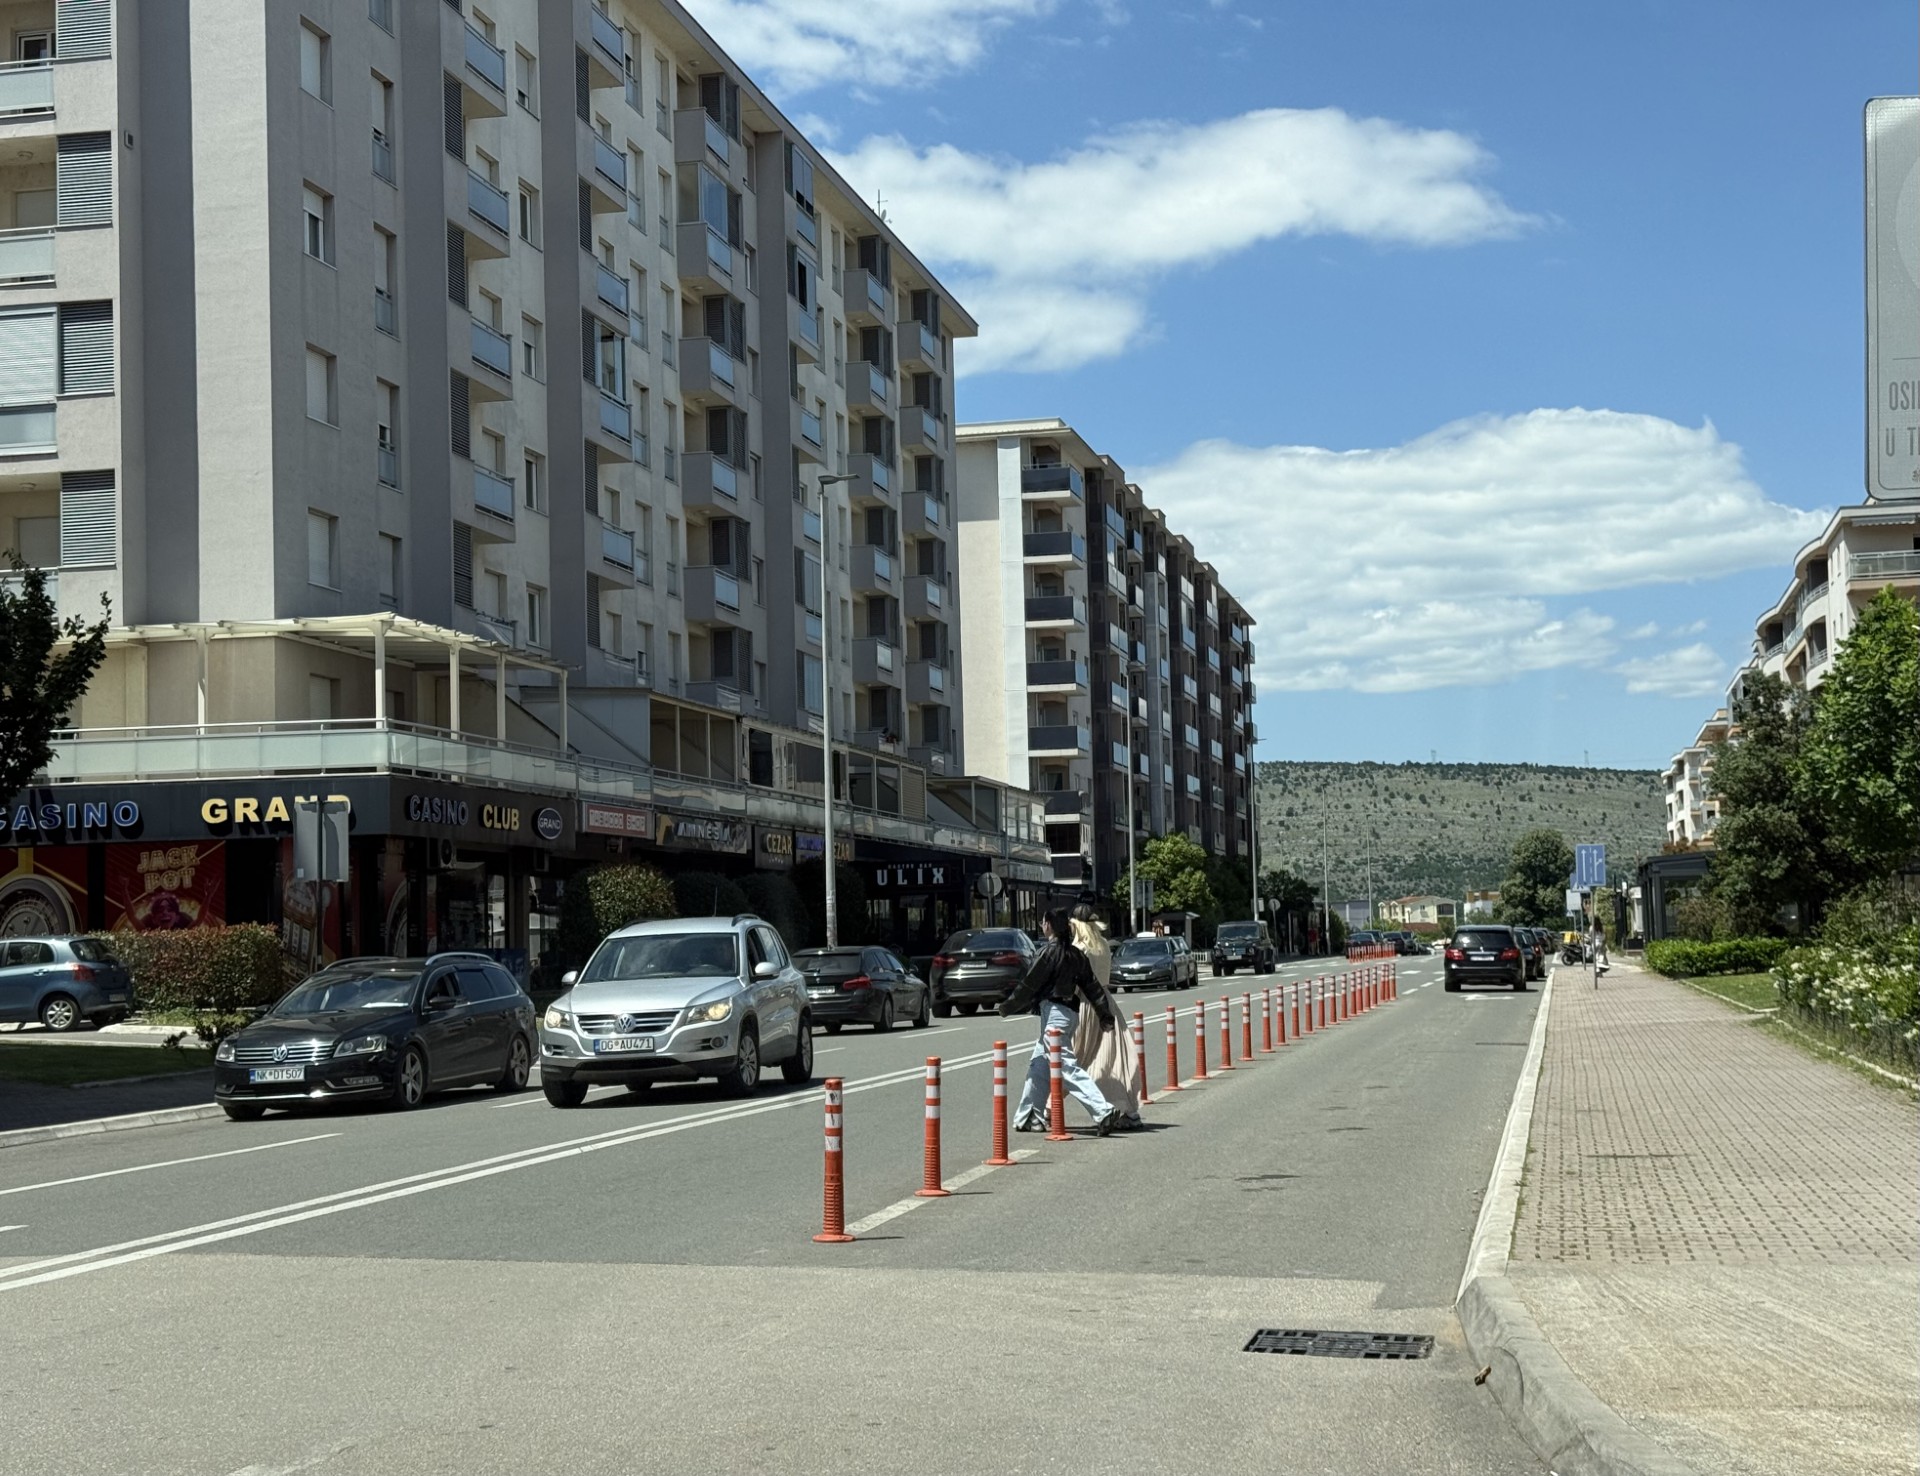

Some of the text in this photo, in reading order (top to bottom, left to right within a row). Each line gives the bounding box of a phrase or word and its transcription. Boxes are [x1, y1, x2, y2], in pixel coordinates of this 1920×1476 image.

[1889, 381, 1920, 411] OSI
[1907, 427, 1920, 456] T
[409, 794, 520, 831] CASINO CLUB
[539, 816, 561, 830] GRAND
[766, 833, 793, 855] CEZAR
[137, 845, 200, 873] JACK
[144, 867, 196, 893] POT
[876, 867, 945, 886] ULIX
[256, 1070, 268, 1080] NK
